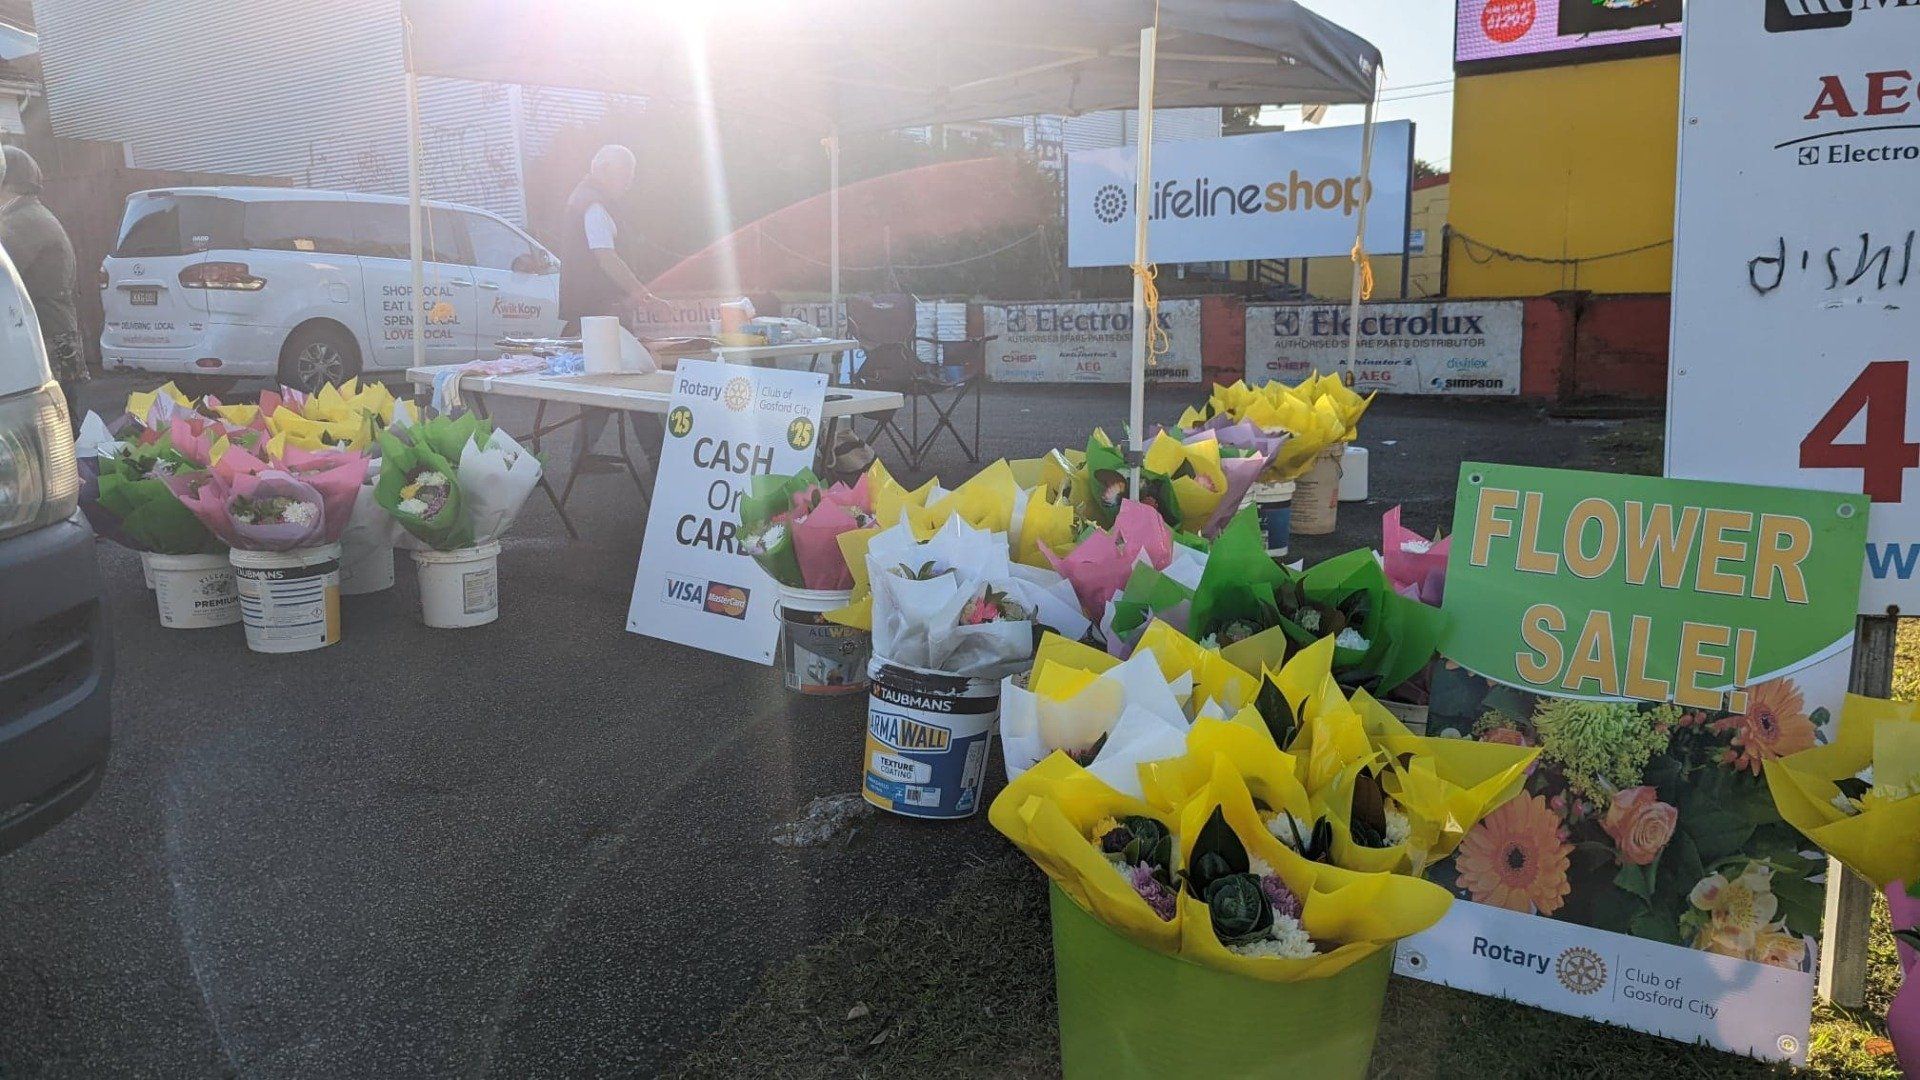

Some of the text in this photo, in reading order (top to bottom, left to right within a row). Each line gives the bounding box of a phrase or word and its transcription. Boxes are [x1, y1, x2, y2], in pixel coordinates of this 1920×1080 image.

[1804, 70, 1920, 120] AE
[383, 301, 405, 311] EAT
[154, 322, 175, 330] LOCAL
[384, 315, 414, 326] SPEN
[1036, 307, 1173, 332] Electrox
[1312, 307, 1485, 337] Electrolux
[385, 329, 414, 340] LOVE
[1275, 338, 1485, 349] AUTHORISED SARE PARTS DISTRIBUTOR
[1359, 371, 1391, 381] AEG
[679, 379, 722, 400] Rotary
[761, 386, 794, 399] Club of
[760, 400, 812, 417] Gosford City
[693, 437, 775, 476] CASH
[1469, 487, 1813, 605] FLOWER
[667, 578, 746, 608] VISA MasterCard
[1515, 603, 1758, 715] SALE!
[881, 687, 952, 711] TAUBMANS
[880, 757, 914, 772] TEXTURE
[880, 766, 912, 779] COATING
[1472, 936, 1551, 974] Rotary
[1625, 967, 1682, 990] Club of
[1623, 985, 1719, 1019] Gosford City
